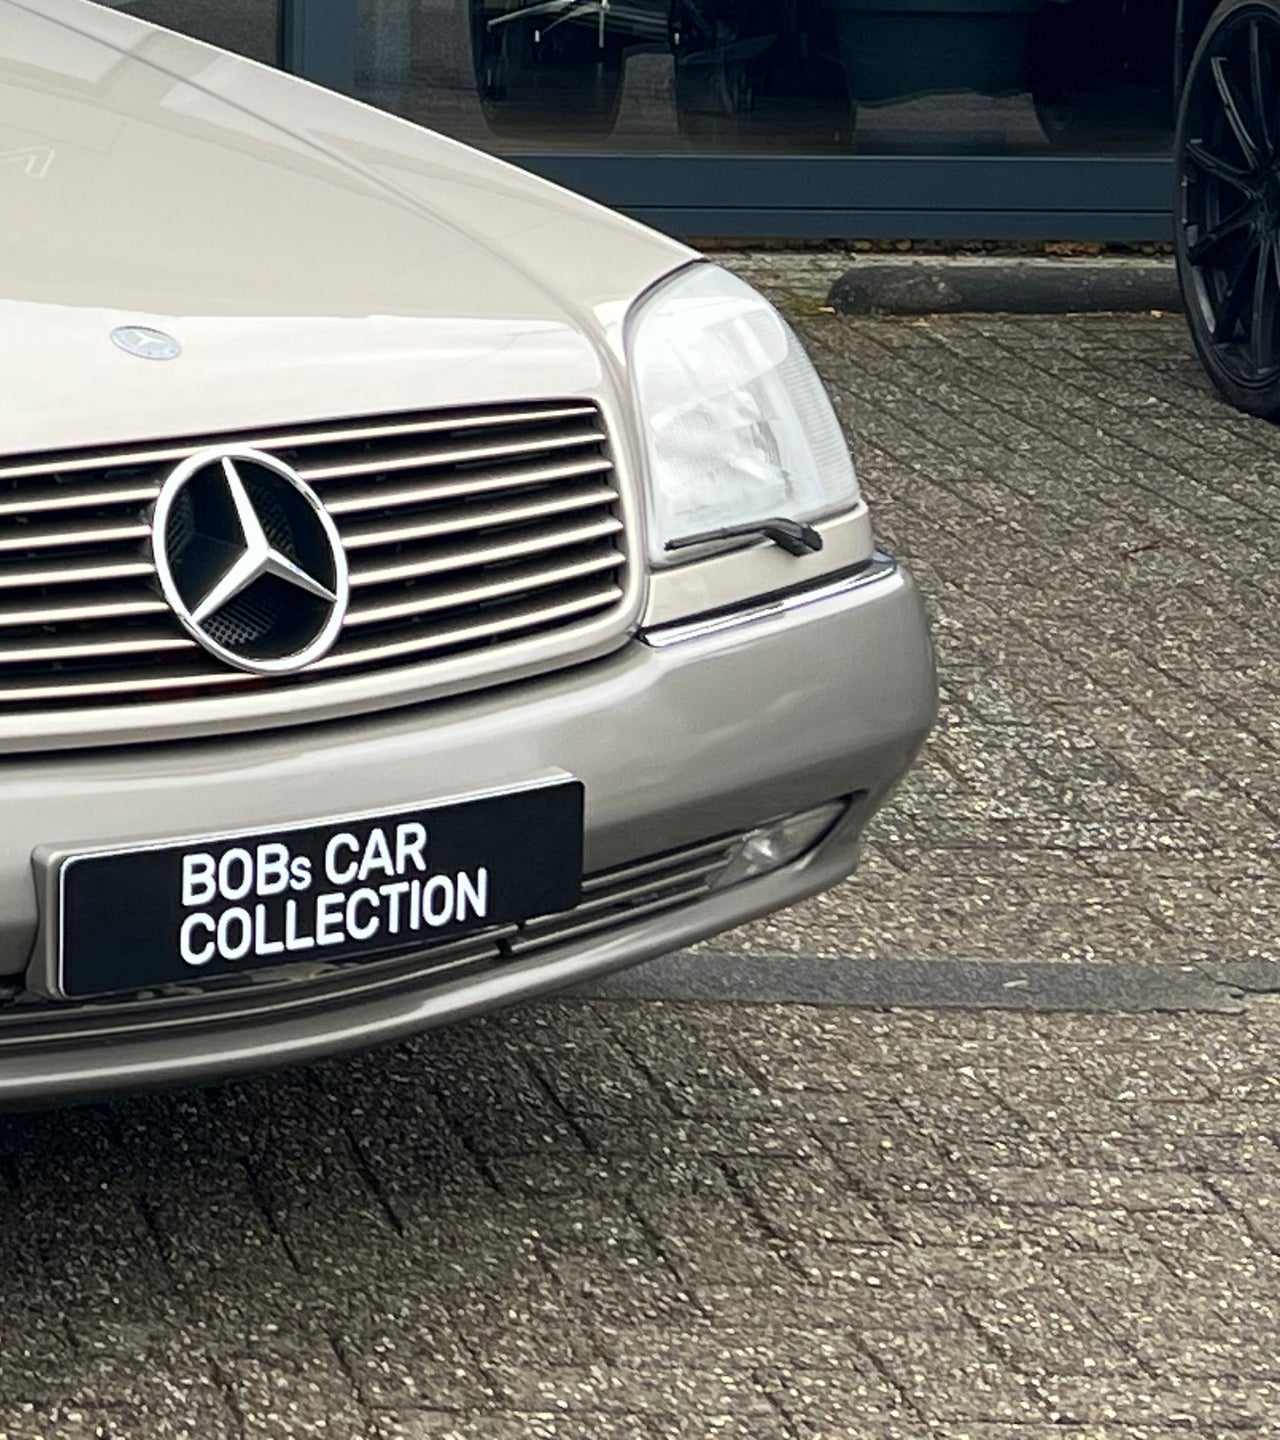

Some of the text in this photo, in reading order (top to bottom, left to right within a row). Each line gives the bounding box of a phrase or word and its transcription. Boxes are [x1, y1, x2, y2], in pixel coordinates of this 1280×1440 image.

[180, 822, 428, 907] BOBs CAR
[179, 866, 489, 966] COLLECTION
